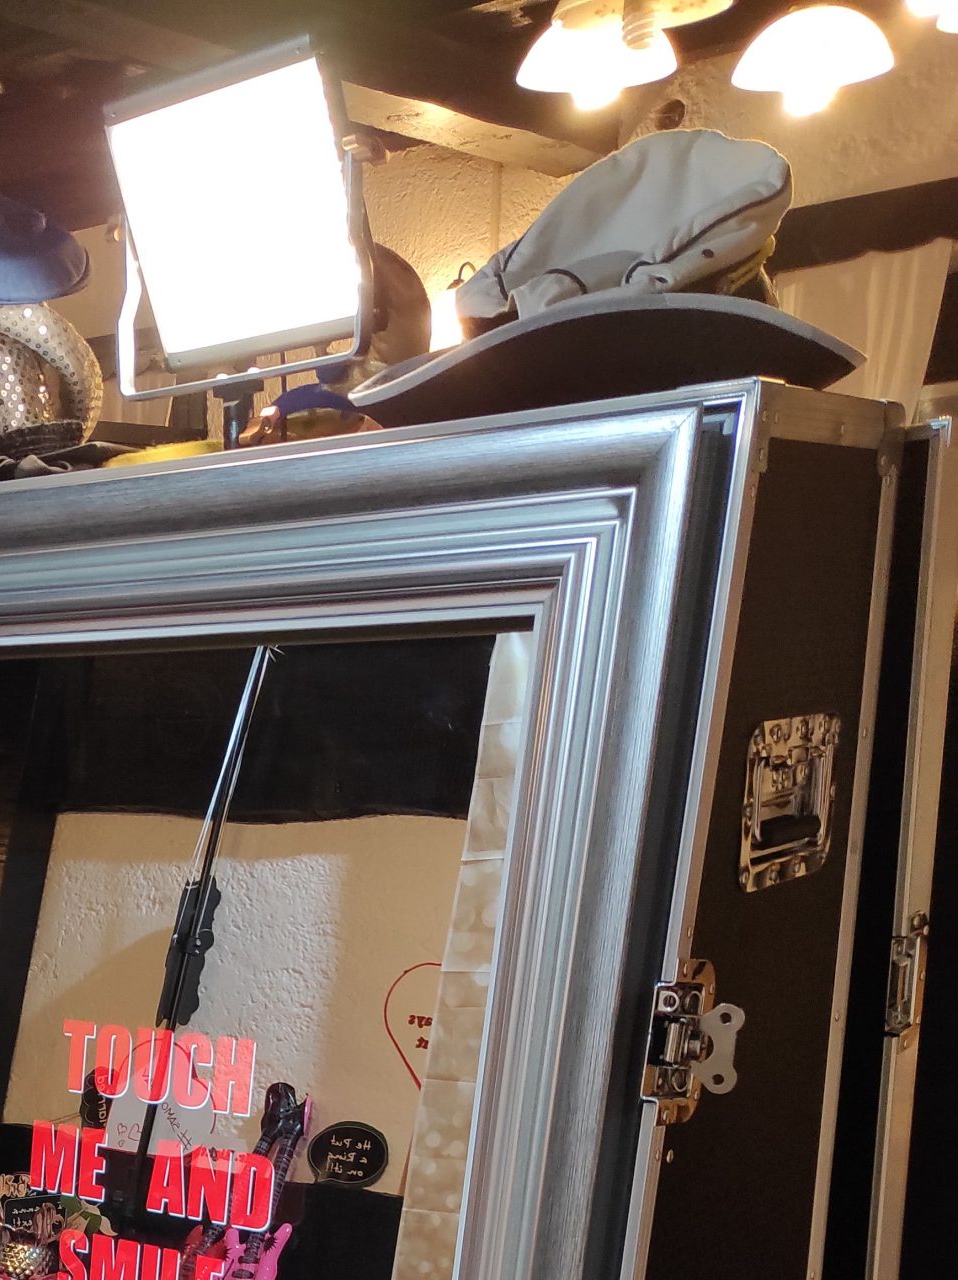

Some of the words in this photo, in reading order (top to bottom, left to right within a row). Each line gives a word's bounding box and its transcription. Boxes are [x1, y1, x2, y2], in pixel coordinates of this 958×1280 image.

[63, 1018, 256, 1117] TOUCH
[30, 1120, 108, 1202] ME
[146, 1139, 275, 1232] AND
